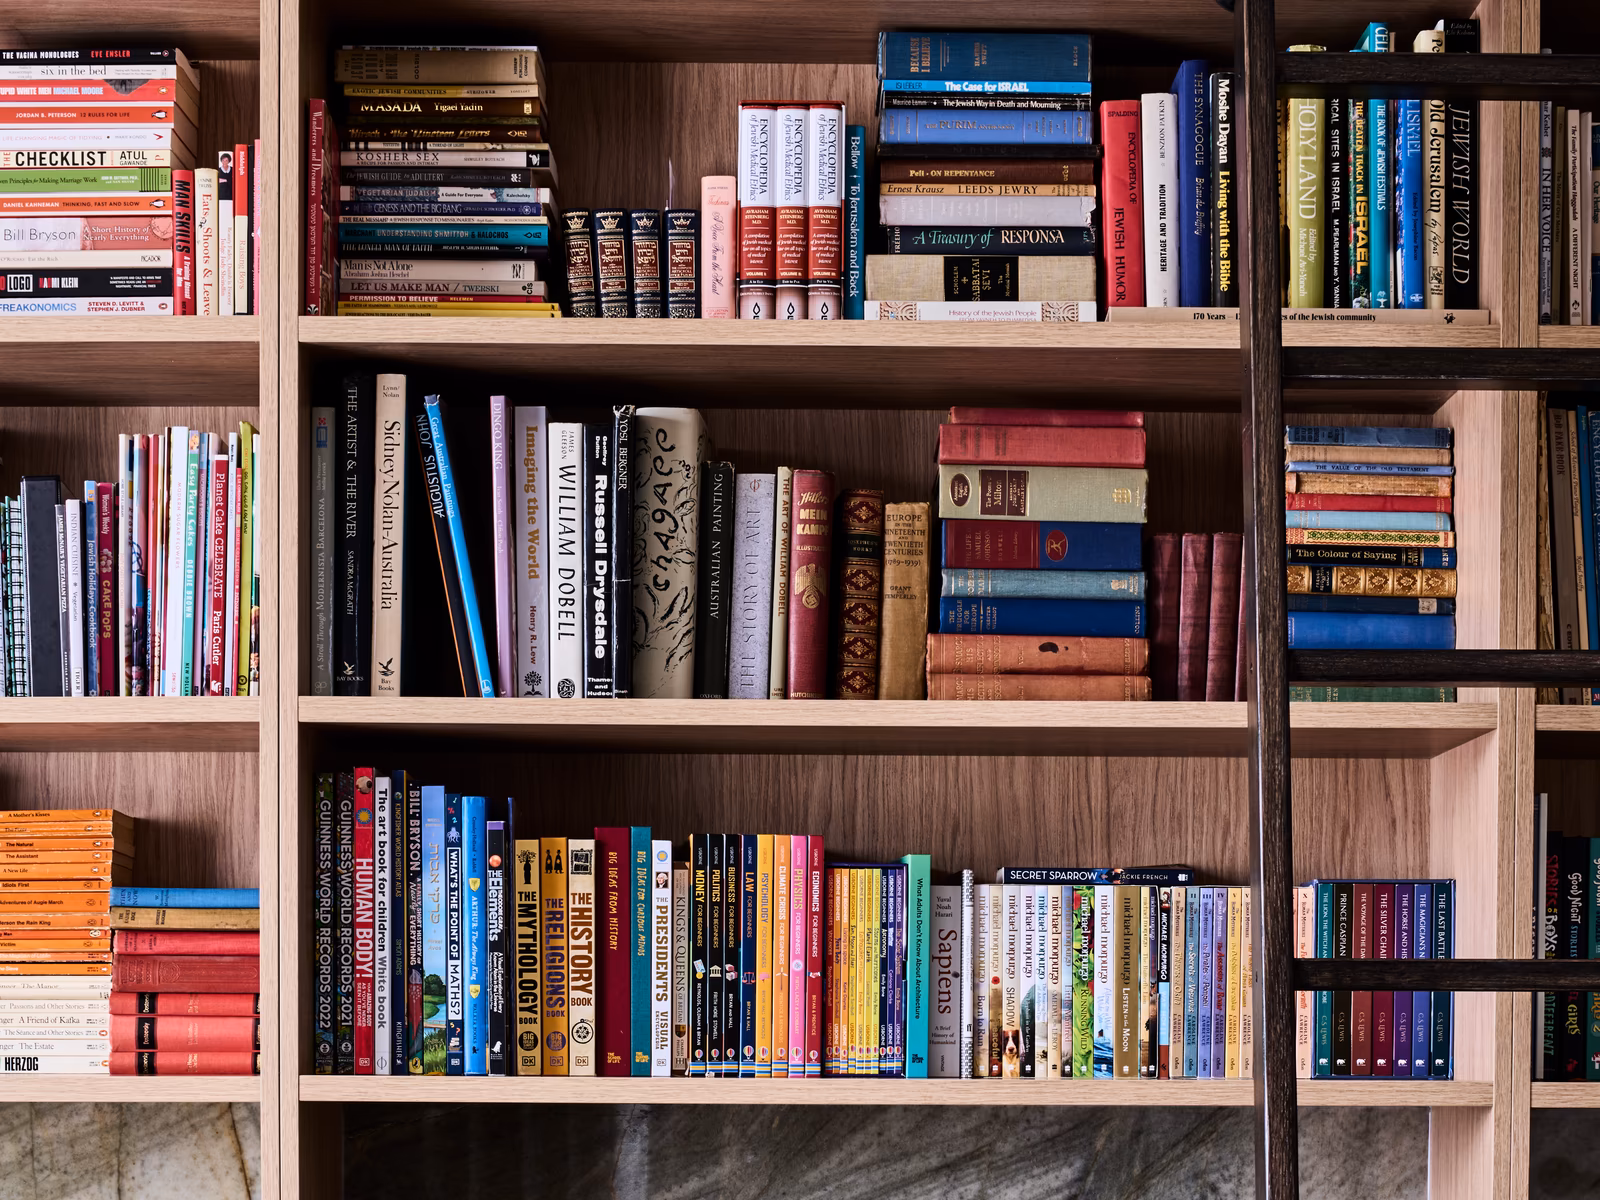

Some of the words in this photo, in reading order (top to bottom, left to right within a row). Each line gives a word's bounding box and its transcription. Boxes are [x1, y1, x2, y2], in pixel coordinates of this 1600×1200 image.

[41, 66, 54, 75] six
[58, 66, 67, 75] in
[70, 66, 85, 75] the
[89, 66, 106, 75] bed
[945, 82, 961, 91] The
[962, 82, 982, 91] Case
[984, 82, 997, 91] for
[998, 83, 1029, 92] ISRAEL
[1218, 79, 1229, 121] Moshe
[16, 152, 106, 166] CHECKLIST
[120, 151, 147, 160] ATUL
[357, 152, 408, 161] KOSHER
[760, 119, 768, 194] ENCYCLOPEDIA
[828, 119, 836, 194] ENCYCLOPEDIA
[850, 136, 860, 168] Bellow
[1219, 123, 1230, 163] Dayan
[1448, 104, 1470, 195] JEWISH
[1426, 128, 1444, 213] Jerusalem
[1542, 168, 1550, 181] IN
[175, 180, 190, 208] MAN
[850, 184, 860, 195] To
[999, 186, 1038, 195] JEWRY
[1217, 170, 1230, 209] Living
[1299, 156, 1316, 219] LAND
[4, 229, 24, 240] Bill
[30, 228, 76, 241] Bryson
[176, 212, 190, 254] SKILLS
[849, 197, 860, 248] Jerusalem
[912, 231, 926, 244] A
[929, 230, 979, 248] Treasury
[981, 228, 995, 247] of
[1001, 230, 1064, 243] RESPONSA
[1114, 208, 1124, 249] JEWISH
[1219, 213, 1230, 235] with
[1356, 196, 1368, 274] ISRAEL
[202, 228, 212, 265] Shoots
[1220, 238, 1230, 257] the
[1452, 200, 1470, 284] WORLD
[203, 268, 212, 278] &
[850, 250, 859, 268] and
[9, 276, 30, 290] LOGO
[351, 283, 371, 291] LET
[374, 283, 388, 291] US
[390, 283, 422, 292] MAKE
[425, 284, 450, 292] MAN
[850, 271, 859, 297] Back
[1115, 256, 1126, 301] HUMOR
[1220, 260, 1230, 292] Bible
[348, 387, 357, 411] THE
[348, 415, 357, 456] ARTIST
[493, 403, 501, 444] DINGO
[618, 418, 627, 444] YOSL
[347, 460, 356, 470] &
[379, 420, 401, 478] Sidney
[494, 445, 502, 470] KING
[524, 426, 538, 493] Imaging
[189, 464, 197, 486] Easy
[618, 448, 627, 490] BERGNER
[215, 473, 225, 506] Planet
[347, 474, 356, 497] THE
[187, 489, 197, 516] Party
[526, 497, 538, 524] the
[558, 465, 576, 555] WILLIAM
[595, 475, 608, 554] Russell
[714, 474, 723, 532] PAINTING
[187, 518, 195, 546] Cakes
[215, 509, 224, 534] Cake
[346, 500, 356, 538] RIVER
[380, 480, 400, 610] Nolan-Australia
[528, 530, 540, 580] World
[1296, 549, 1314, 558] The
[1318, 550, 1348, 558] Colour
[1352, 550, 1361, 559] of
[1364, 551, 1396, 561] Saying
[214, 538, 224, 598] CELEBRATE
[710, 541, 720, 618] AUSTRALIAN
[103, 580, 111, 608] CAKE
[558, 568, 576, 640] DOBELL
[594, 560, 608, 659] Drysdale
[102, 611, 111, 638] POPS
[213, 611, 221, 634] Paris
[212, 637, 222, 665] Cutler
[379, 788, 387, 812] The
[410, 790, 420, 814] BILL
[319, 801, 331, 870] GUINNESS
[379, 815, 387, 836] art
[378, 841, 387, 874] book
[410, 820, 420, 870] BRYSON
[356, 858, 372, 923] HUMAN
[378, 878, 387, 896] for
[696, 870, 704, 902] MONEY
[745, 872, 754, 892] LAW
[1010, 870, 1047, 879] SECRET
[1049, 871, 1097, 880] SPARROW
[320, 874, 331, 923] WORLD
[518, 891, 536, 901] THE
[546, 898, 563, 908] THE
[571, 893, 591, 904] THE
[378, 900, 387, 952] children
[450, 910, 458, 942] POINT
[319, 928, 331, 992] RECORDS
[356, 928, 373, 978] BODY!
[450, 944, 458, 958] OF
[518, 904, 537, 1016] MYTHOLOGY
[546, 911, 565, 1009] RELIGIONS
[571, 908, 592, 995] HISTORY
[656, 906, 668, 1002] PRESIDENTS
[378, 956, 387, 992] White
[932, 929, 957, 1014] Sapiens
[450, 964, 460, 1016] MATHS?
[571, 997, 592, 1006] BOOK
[319, 996, 331, 1028] 2022
[378, 996, 386, 1028] book
[1006, 988, 1015, 1027] SHADOW
[5, 1057, 38, 1071] HERZOG
